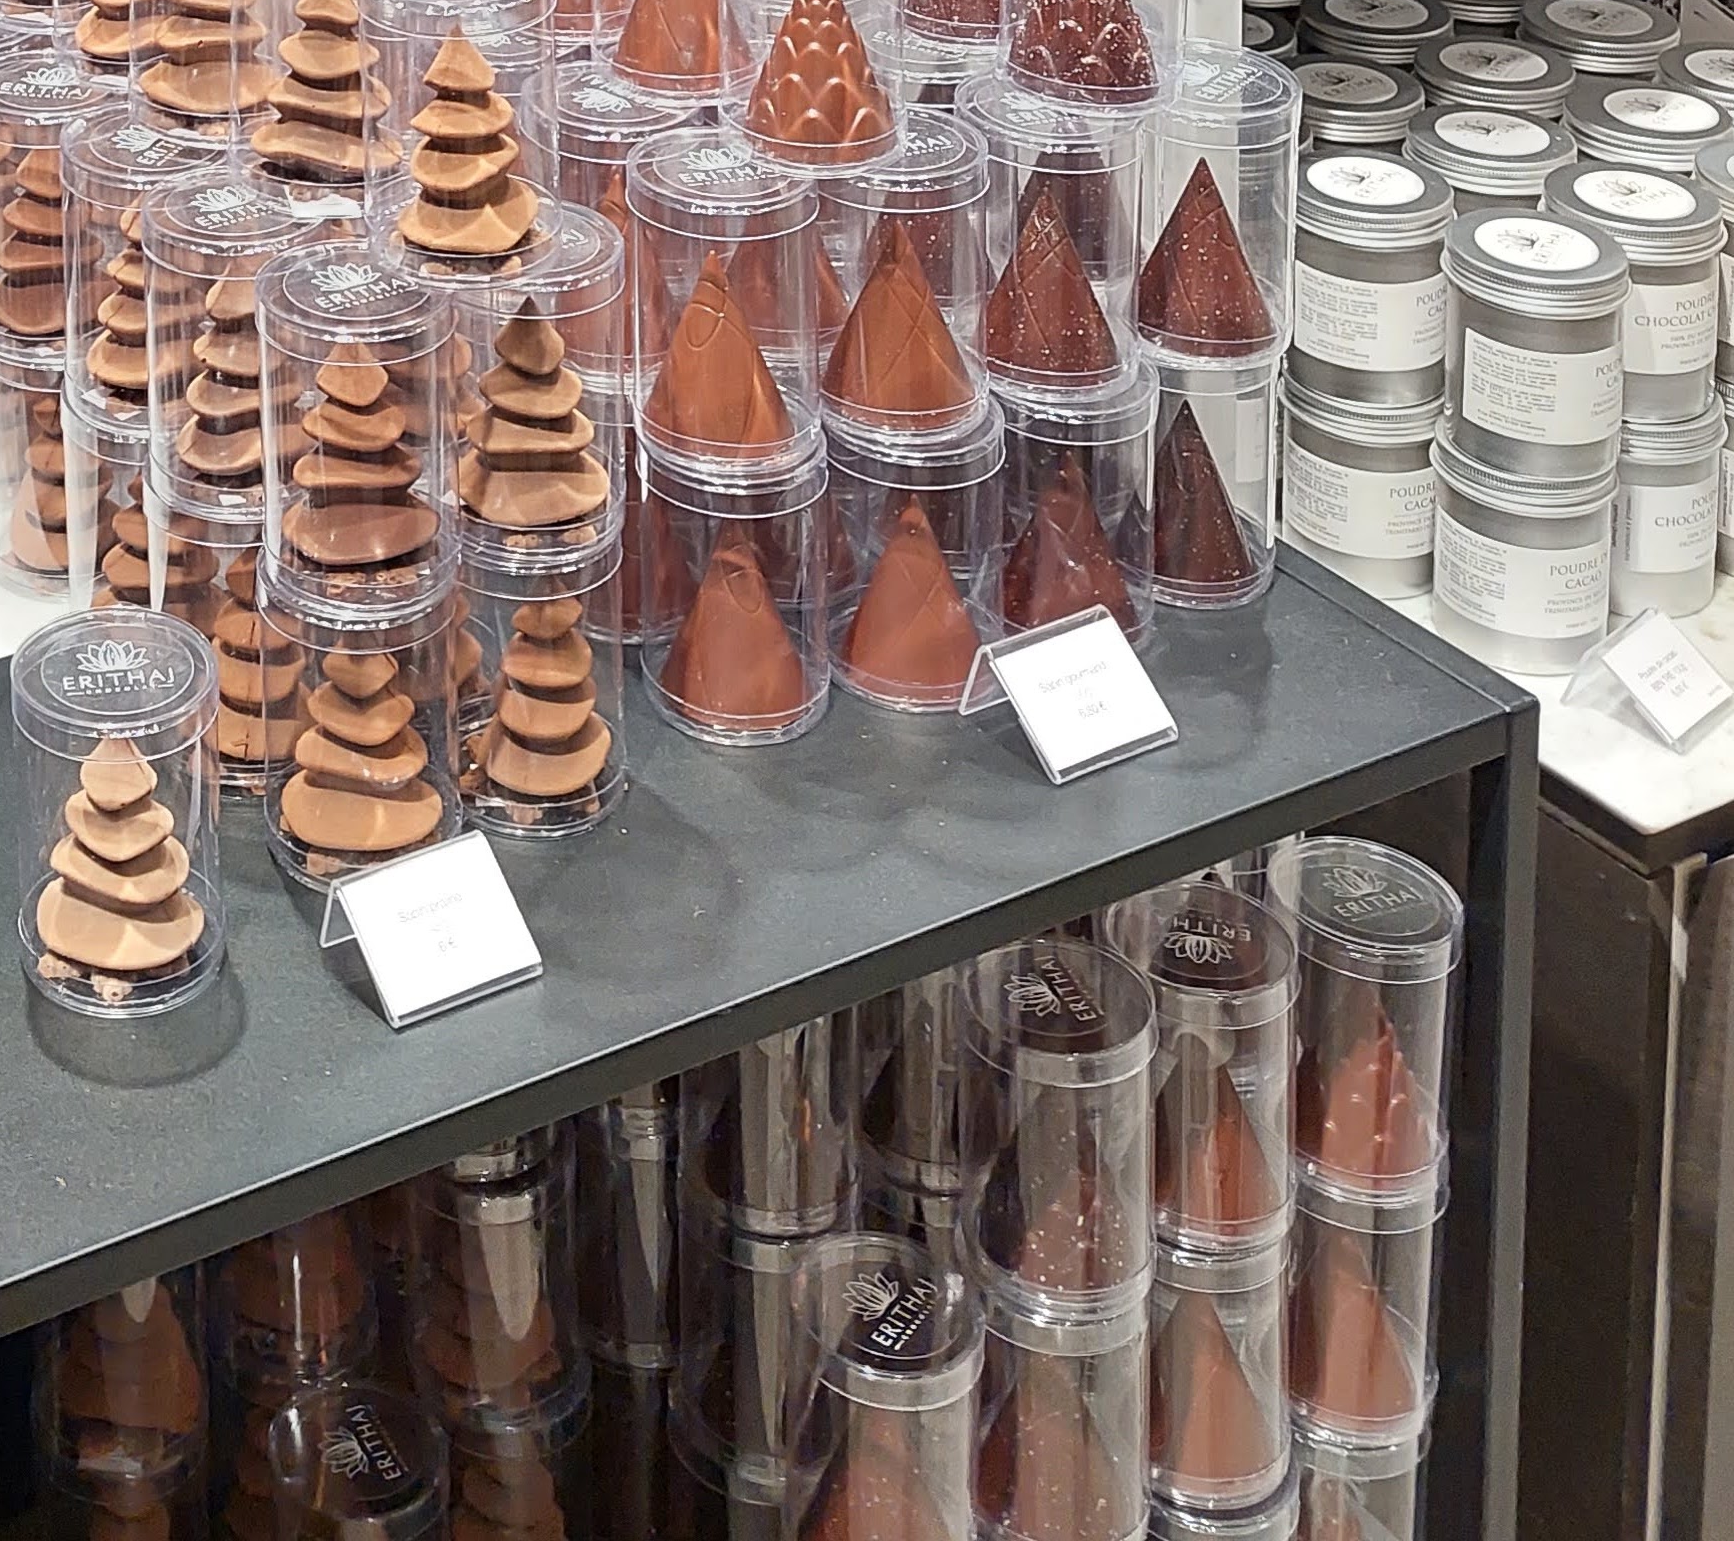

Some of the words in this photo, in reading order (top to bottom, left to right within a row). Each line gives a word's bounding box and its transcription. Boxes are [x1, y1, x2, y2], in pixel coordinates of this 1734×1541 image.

[679, 166, 776, 184] ERITHA
[1634, 309, 1706, 328] CHOCOLAT
[1564, 569, 1602, 590] CACAO
[63, 666, 175, 692] ERITHAJ
[1173, 917, 1253, 942] ERITH
[869, 1277, 938, 1347] ERITHAJ
[345, 1404, 403, 1481] ERITHAJ
